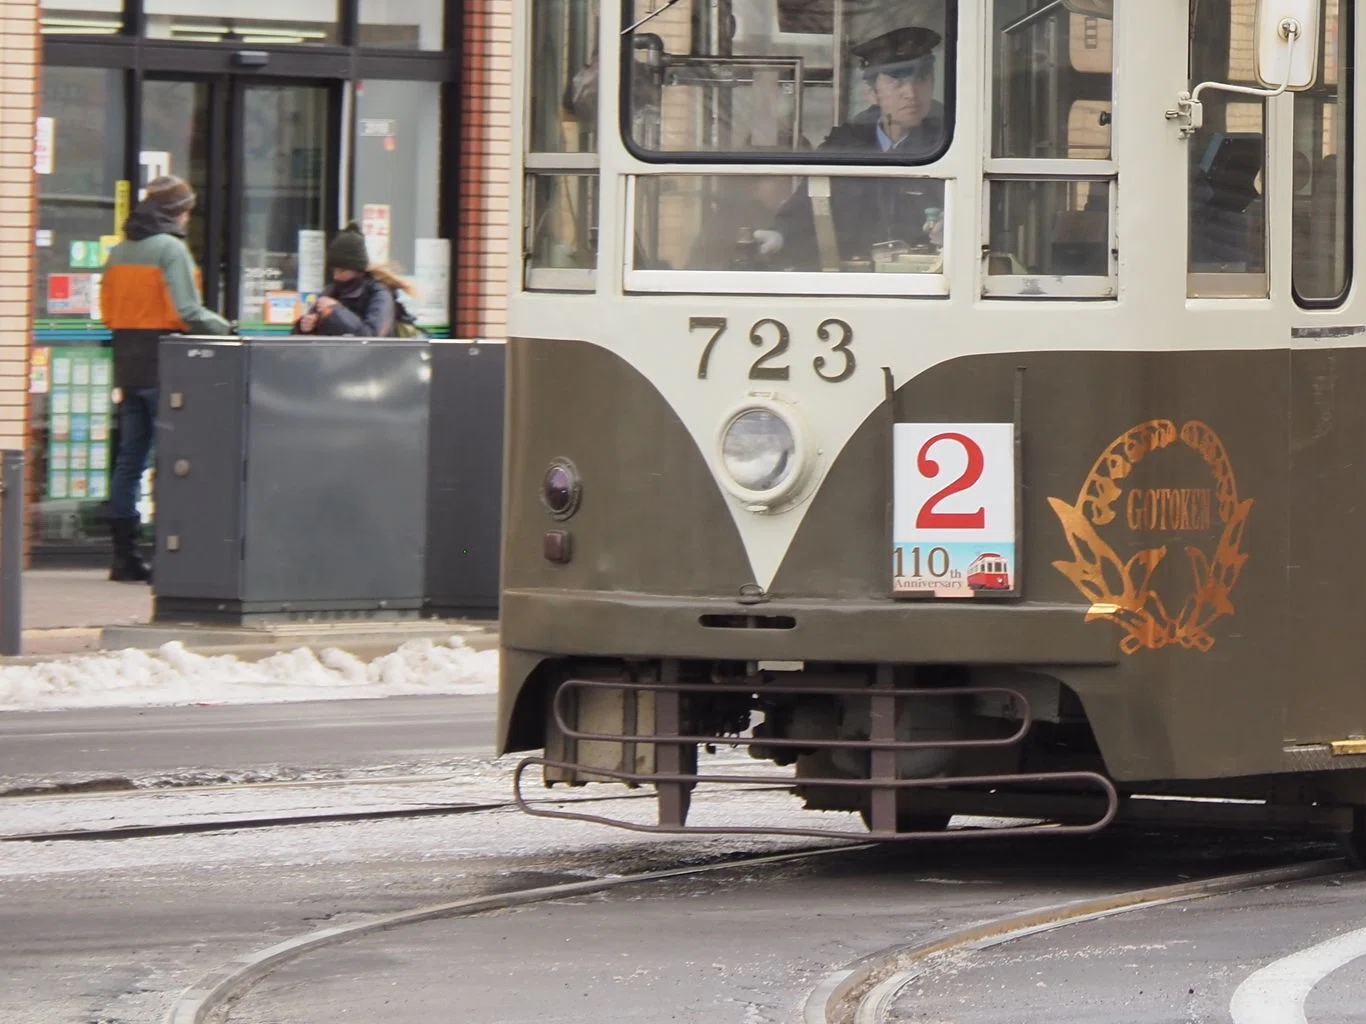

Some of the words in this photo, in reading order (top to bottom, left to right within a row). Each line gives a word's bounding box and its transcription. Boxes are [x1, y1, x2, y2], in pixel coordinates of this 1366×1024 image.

[689, 317, 856, 383] 723
[916, 432, 985, 529] 2
[1126, 488, 1210, 531] GOTOKEN
[895, 579, 962, 590] Anniversary
